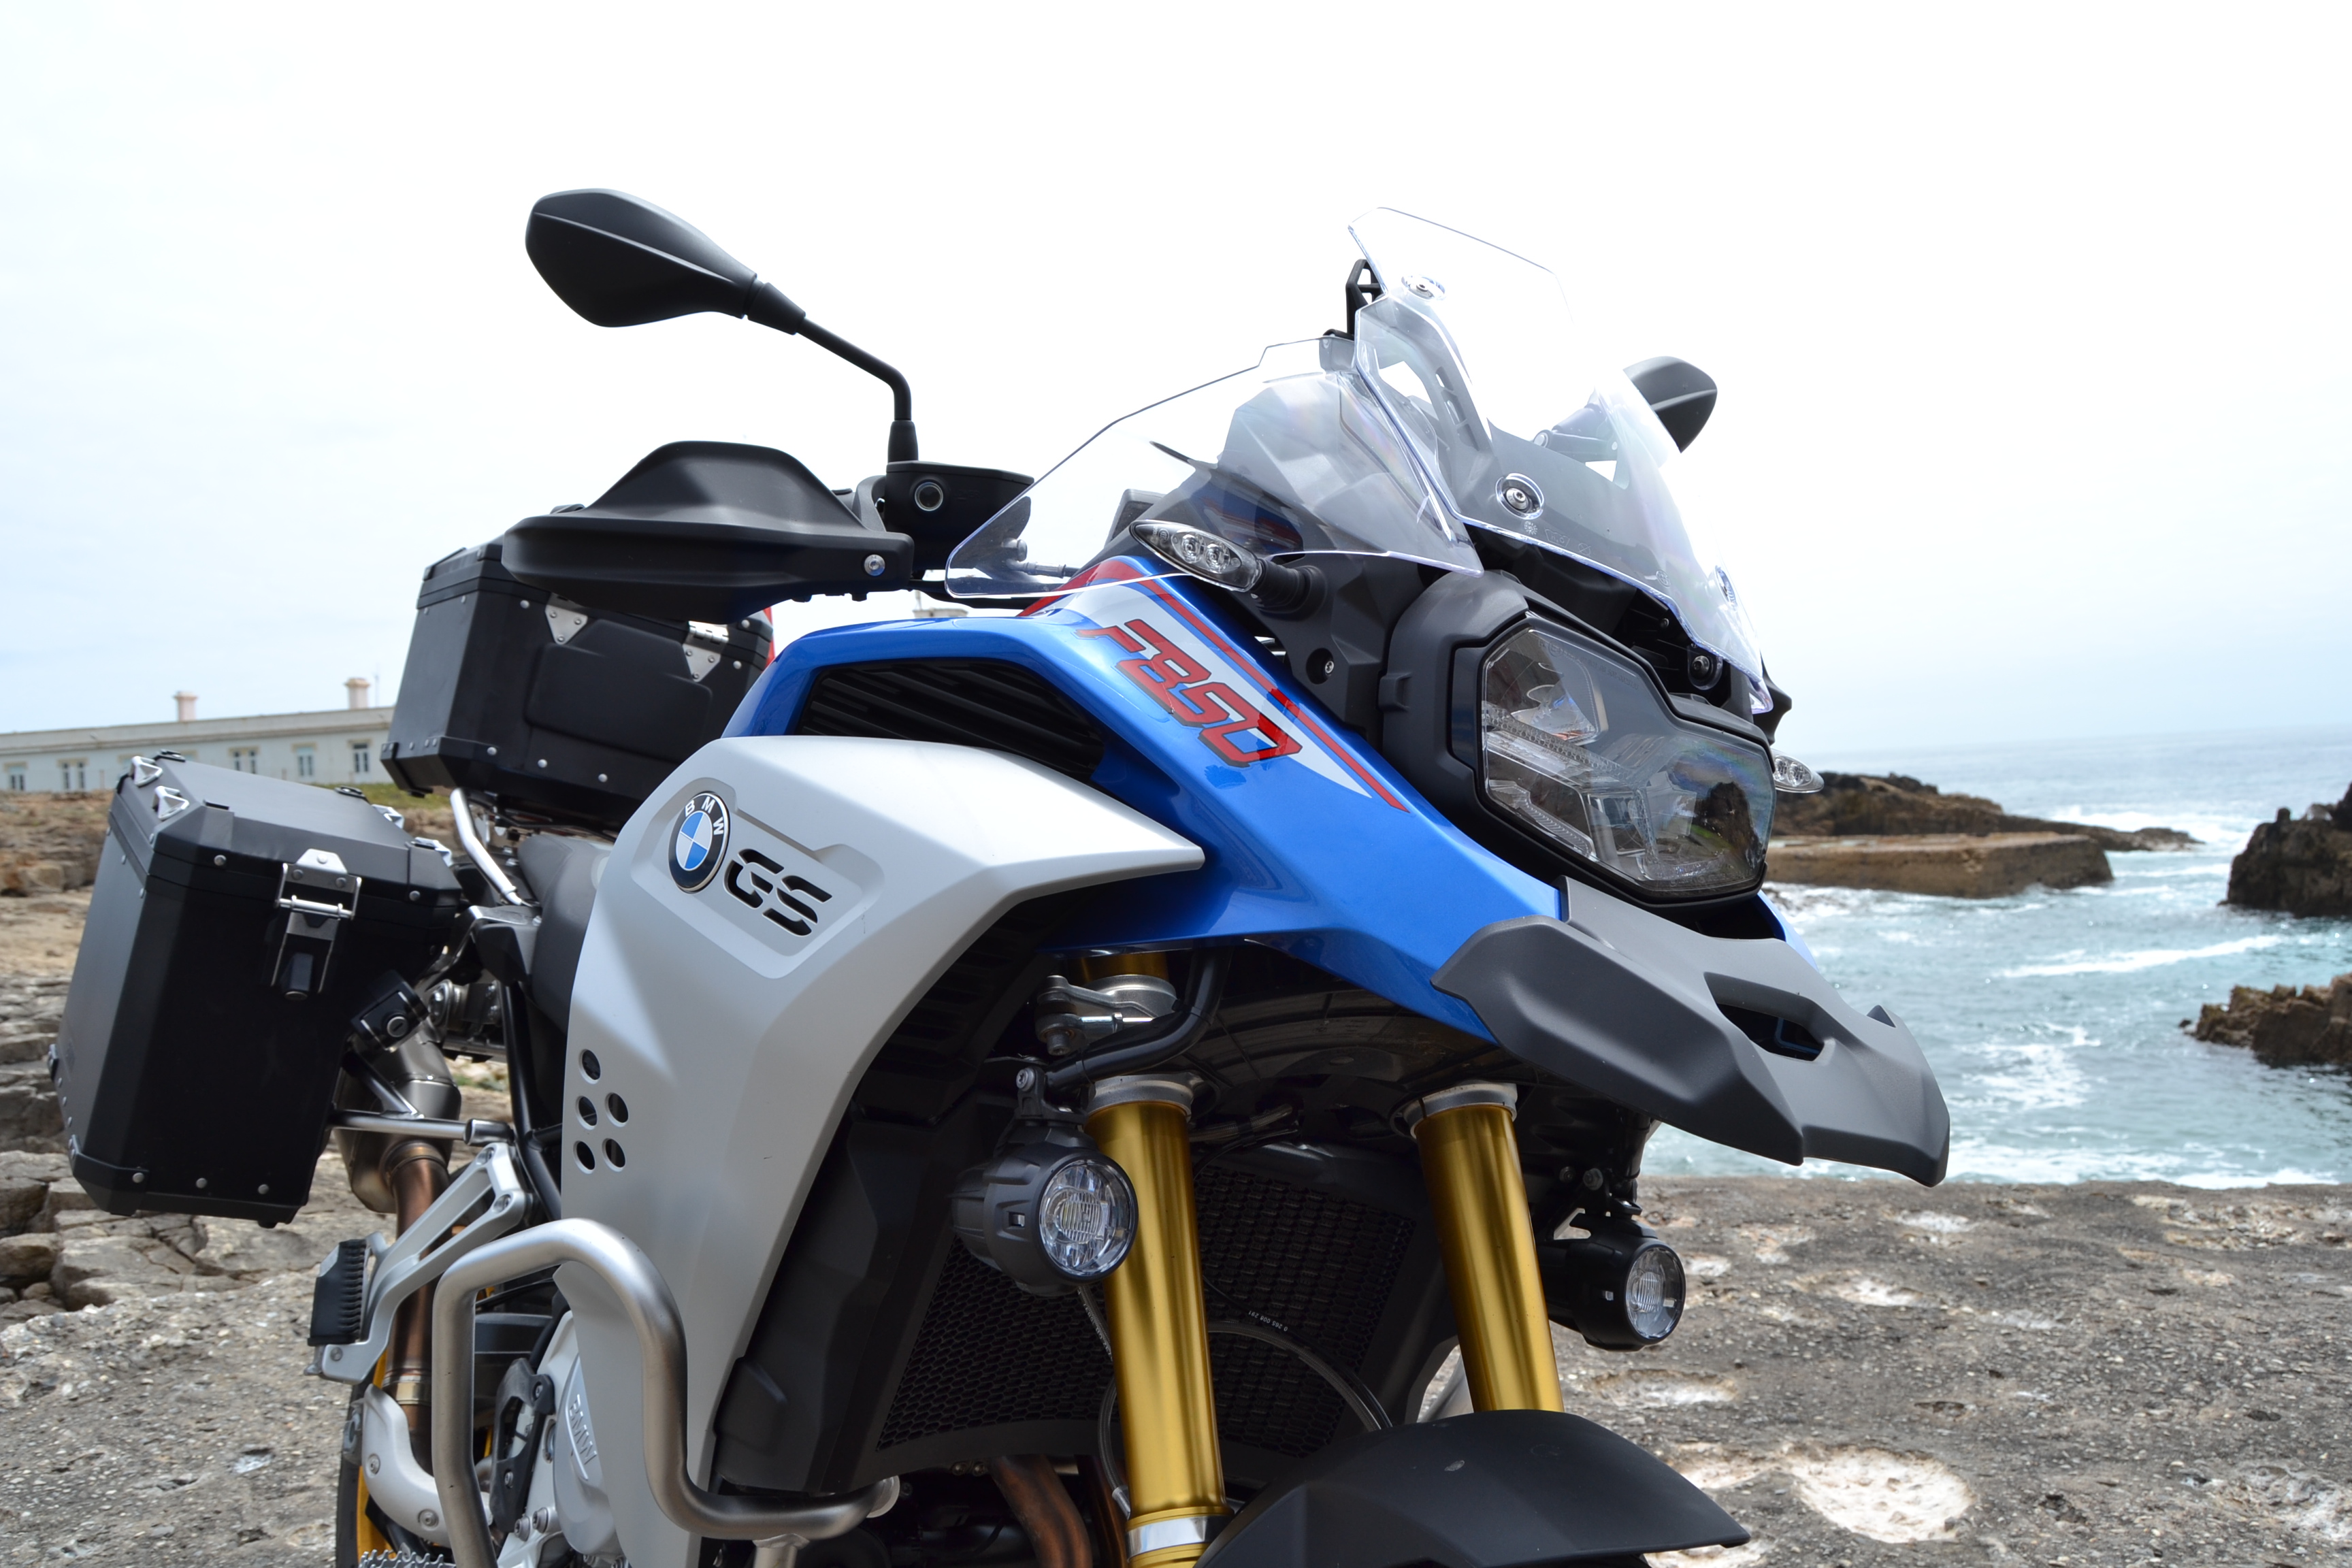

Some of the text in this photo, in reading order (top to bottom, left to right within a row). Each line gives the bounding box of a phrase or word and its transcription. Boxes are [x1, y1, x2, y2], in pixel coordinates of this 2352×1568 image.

[1075, 619, 1303, 767] F850
[685, 796, 724, 835] BMW
[723, 849, 832, 936] GS
[569, 1394, 597, 1465] BMW
